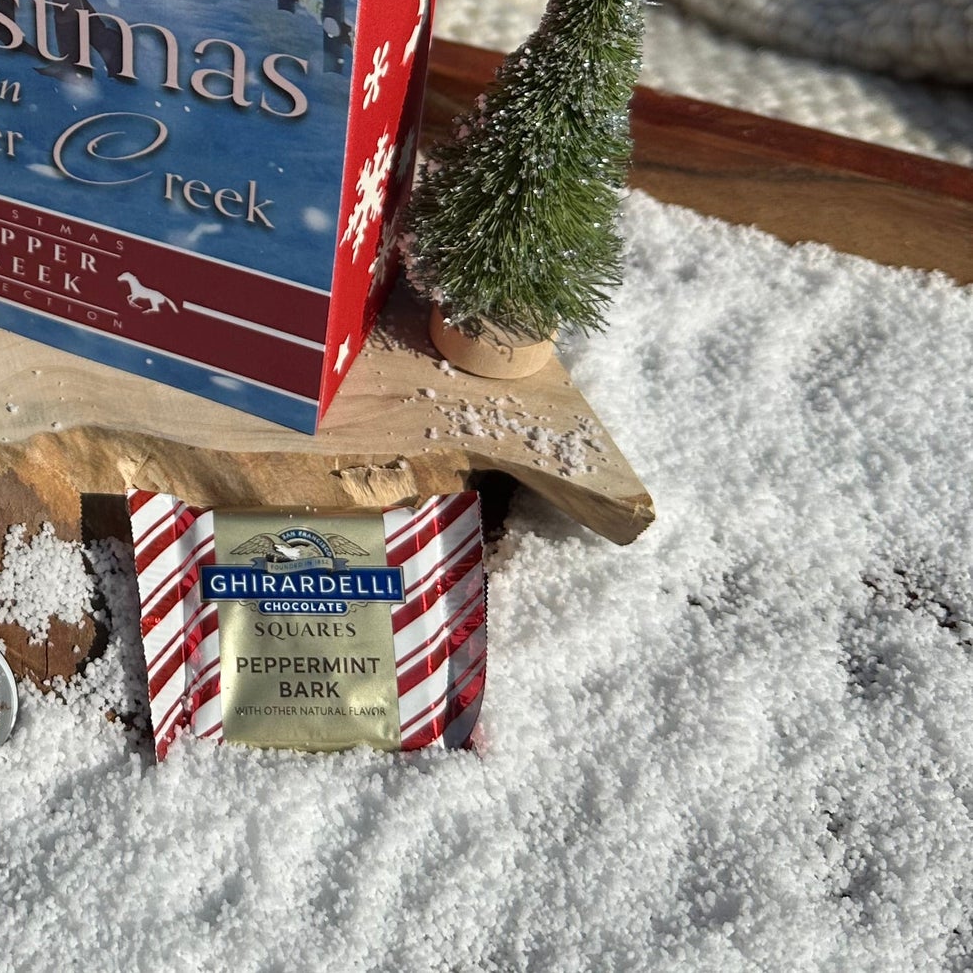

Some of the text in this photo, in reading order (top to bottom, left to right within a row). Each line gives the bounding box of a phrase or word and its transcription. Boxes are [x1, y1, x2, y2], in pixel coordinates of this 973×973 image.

[53, 111, 275, 229] Creek
[298, 530, 333, 558] FRANCISCO
[210, 574, 394, 595] GHIRARDELLI
[264, 602, 343, 612] CHOCOLATE
[254, 622, 357, 640] SQUARES
[236, 656, 381, 675] PEPPERMINT
[279, 681, 341, 699] BARK
[235, 706, 387, 716] WITH OTHER NATURAL FLAVOR
